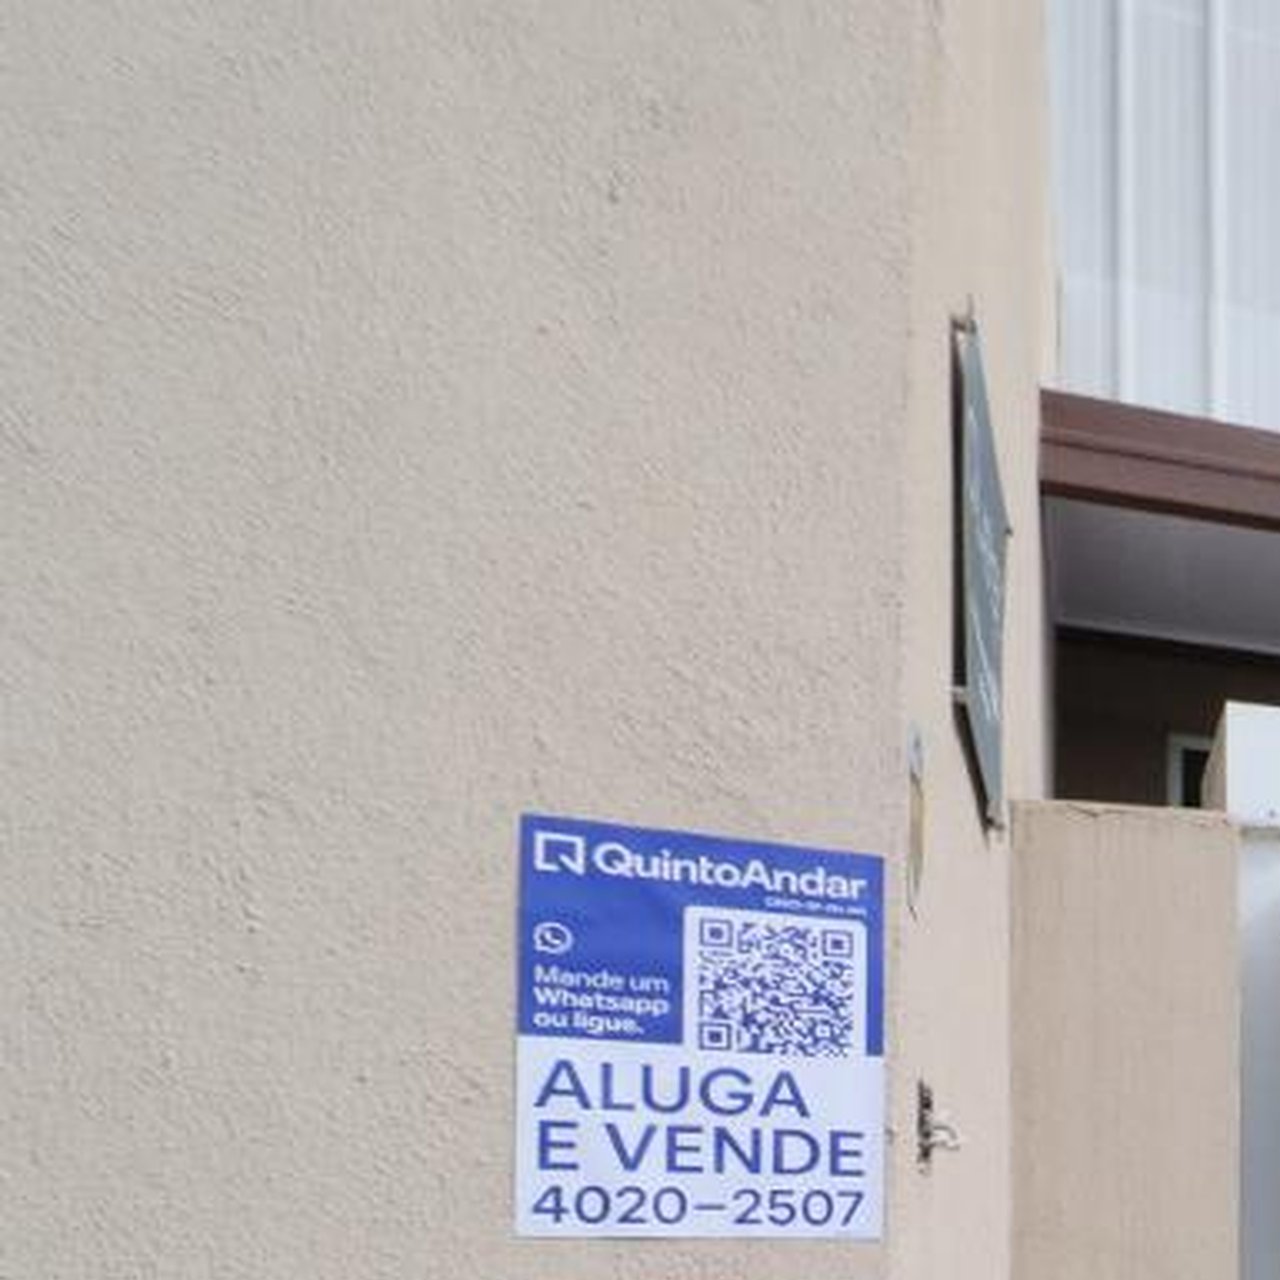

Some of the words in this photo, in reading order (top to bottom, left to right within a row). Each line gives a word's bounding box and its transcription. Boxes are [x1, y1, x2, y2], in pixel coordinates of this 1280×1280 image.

[593, 842, 866, 899] QuintoAndar
[534, 965, 625, 990] Mande
[629, 976, 671, 994] um
[533, 1012, 568, 1028] ou
[533, 1059, 810, 1118] ALUGA
[538, 1120, 579, 1171] E
[604, 1122, 866, 1177] VENDE
[532, 1185, 865, 1226] 4020-2507
